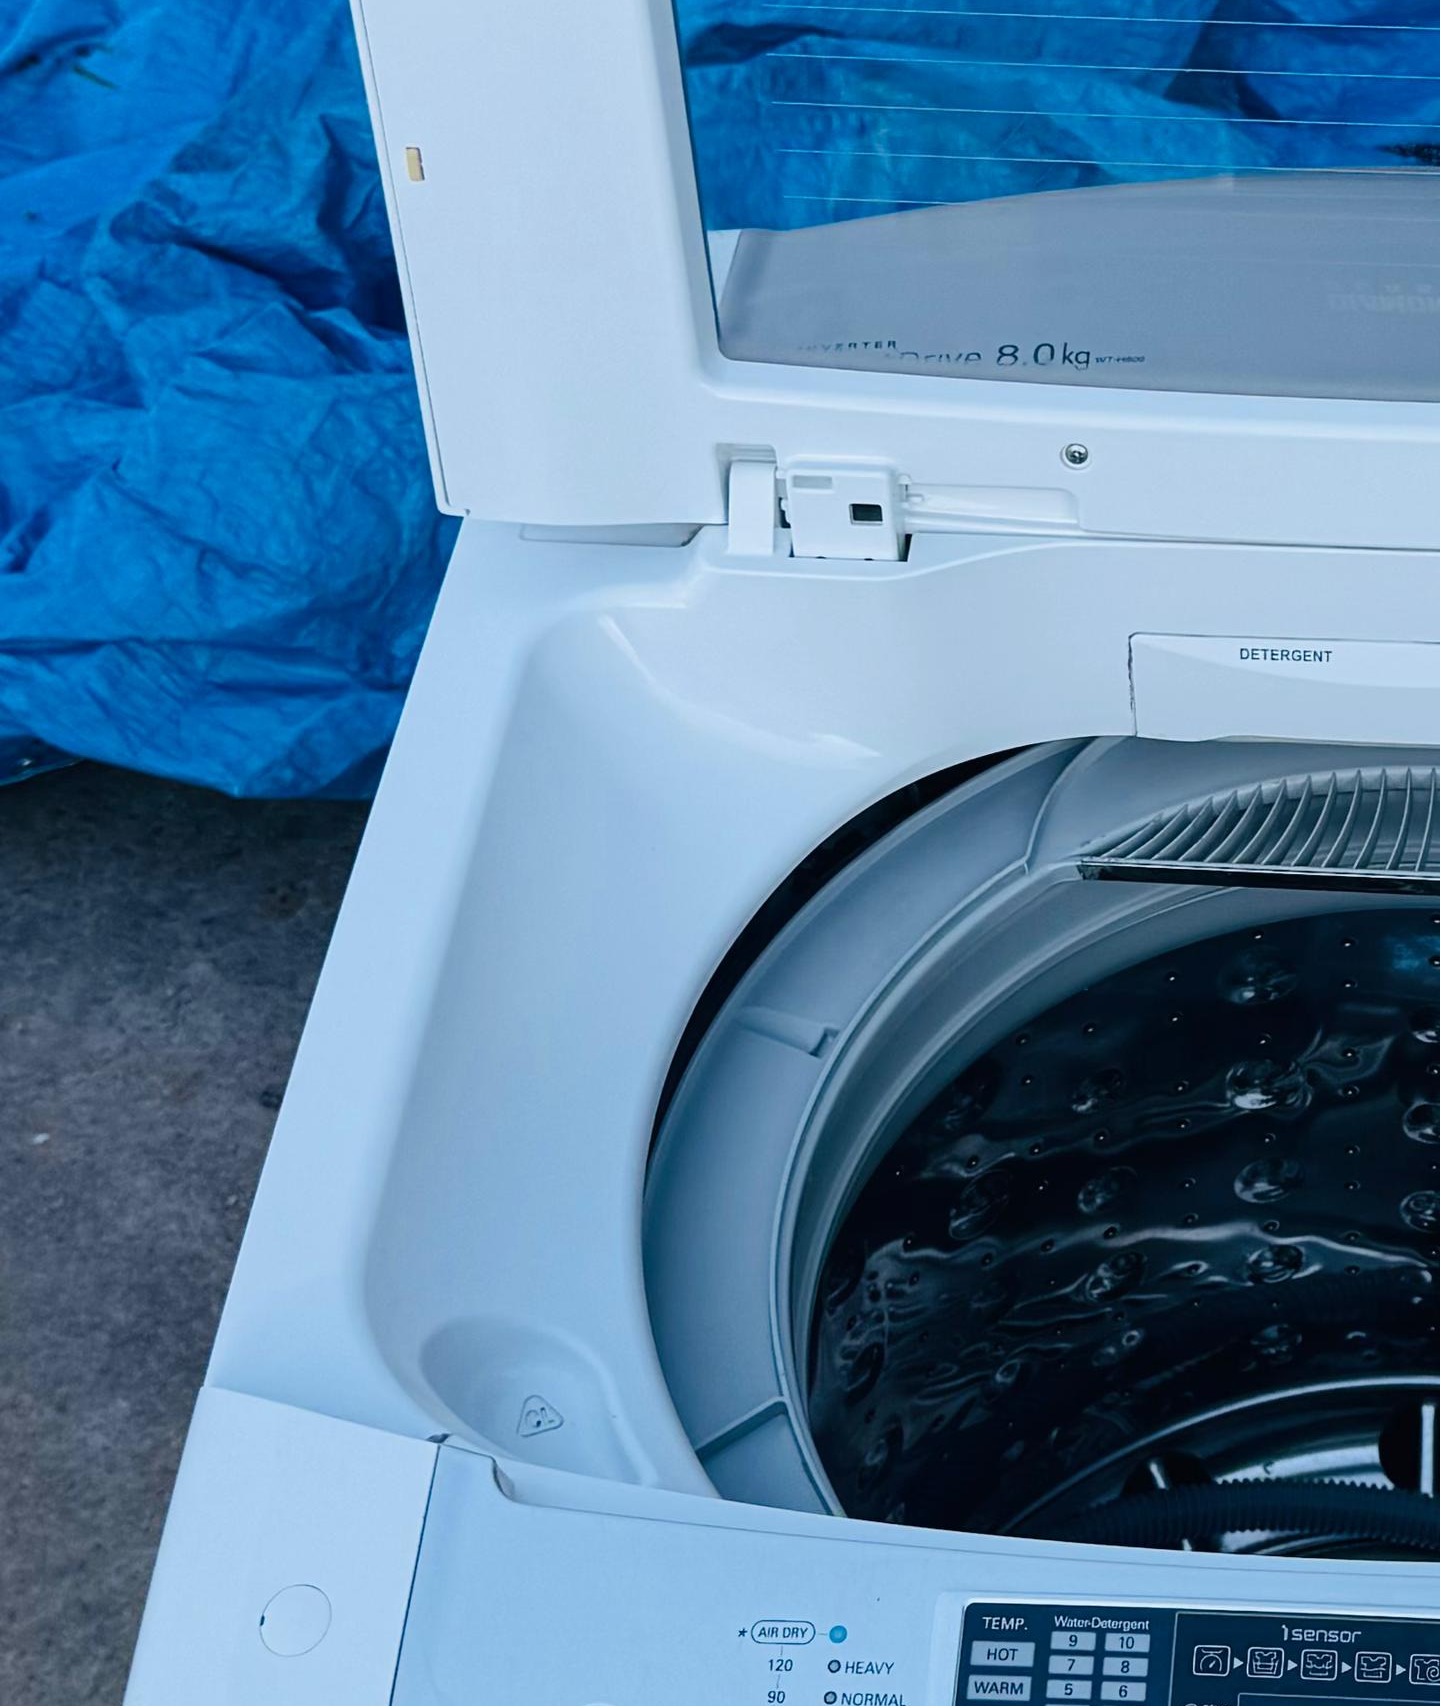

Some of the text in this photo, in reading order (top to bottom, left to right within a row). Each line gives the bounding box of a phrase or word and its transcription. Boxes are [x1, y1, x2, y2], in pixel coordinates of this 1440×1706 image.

[1239, 647, 1332, 663] DETERGENT
[982, 1616, 1028, 1631] TEMP.
[757, 1627, 808, 1639] AIR DRY
[1068, 1634, 1078, 1647] 9
[1119, 1636, 1135, 1649] 10
[986, 1648, 1018, 1661] HOT
[768, 1659, 793, 1672] 120
[844, 1661, 895, 1675] HEAVY
[1067, 1659, 1076, 1671] 7
[1120, 1661, 1130, 1673] 8
[974, 1681, 1024, 1695] WARM
[1064, 1683, 1073, 1696] 5
[1118, 1685, 1128, 1698] 6
[767, 1690, 786, 1704] 90
